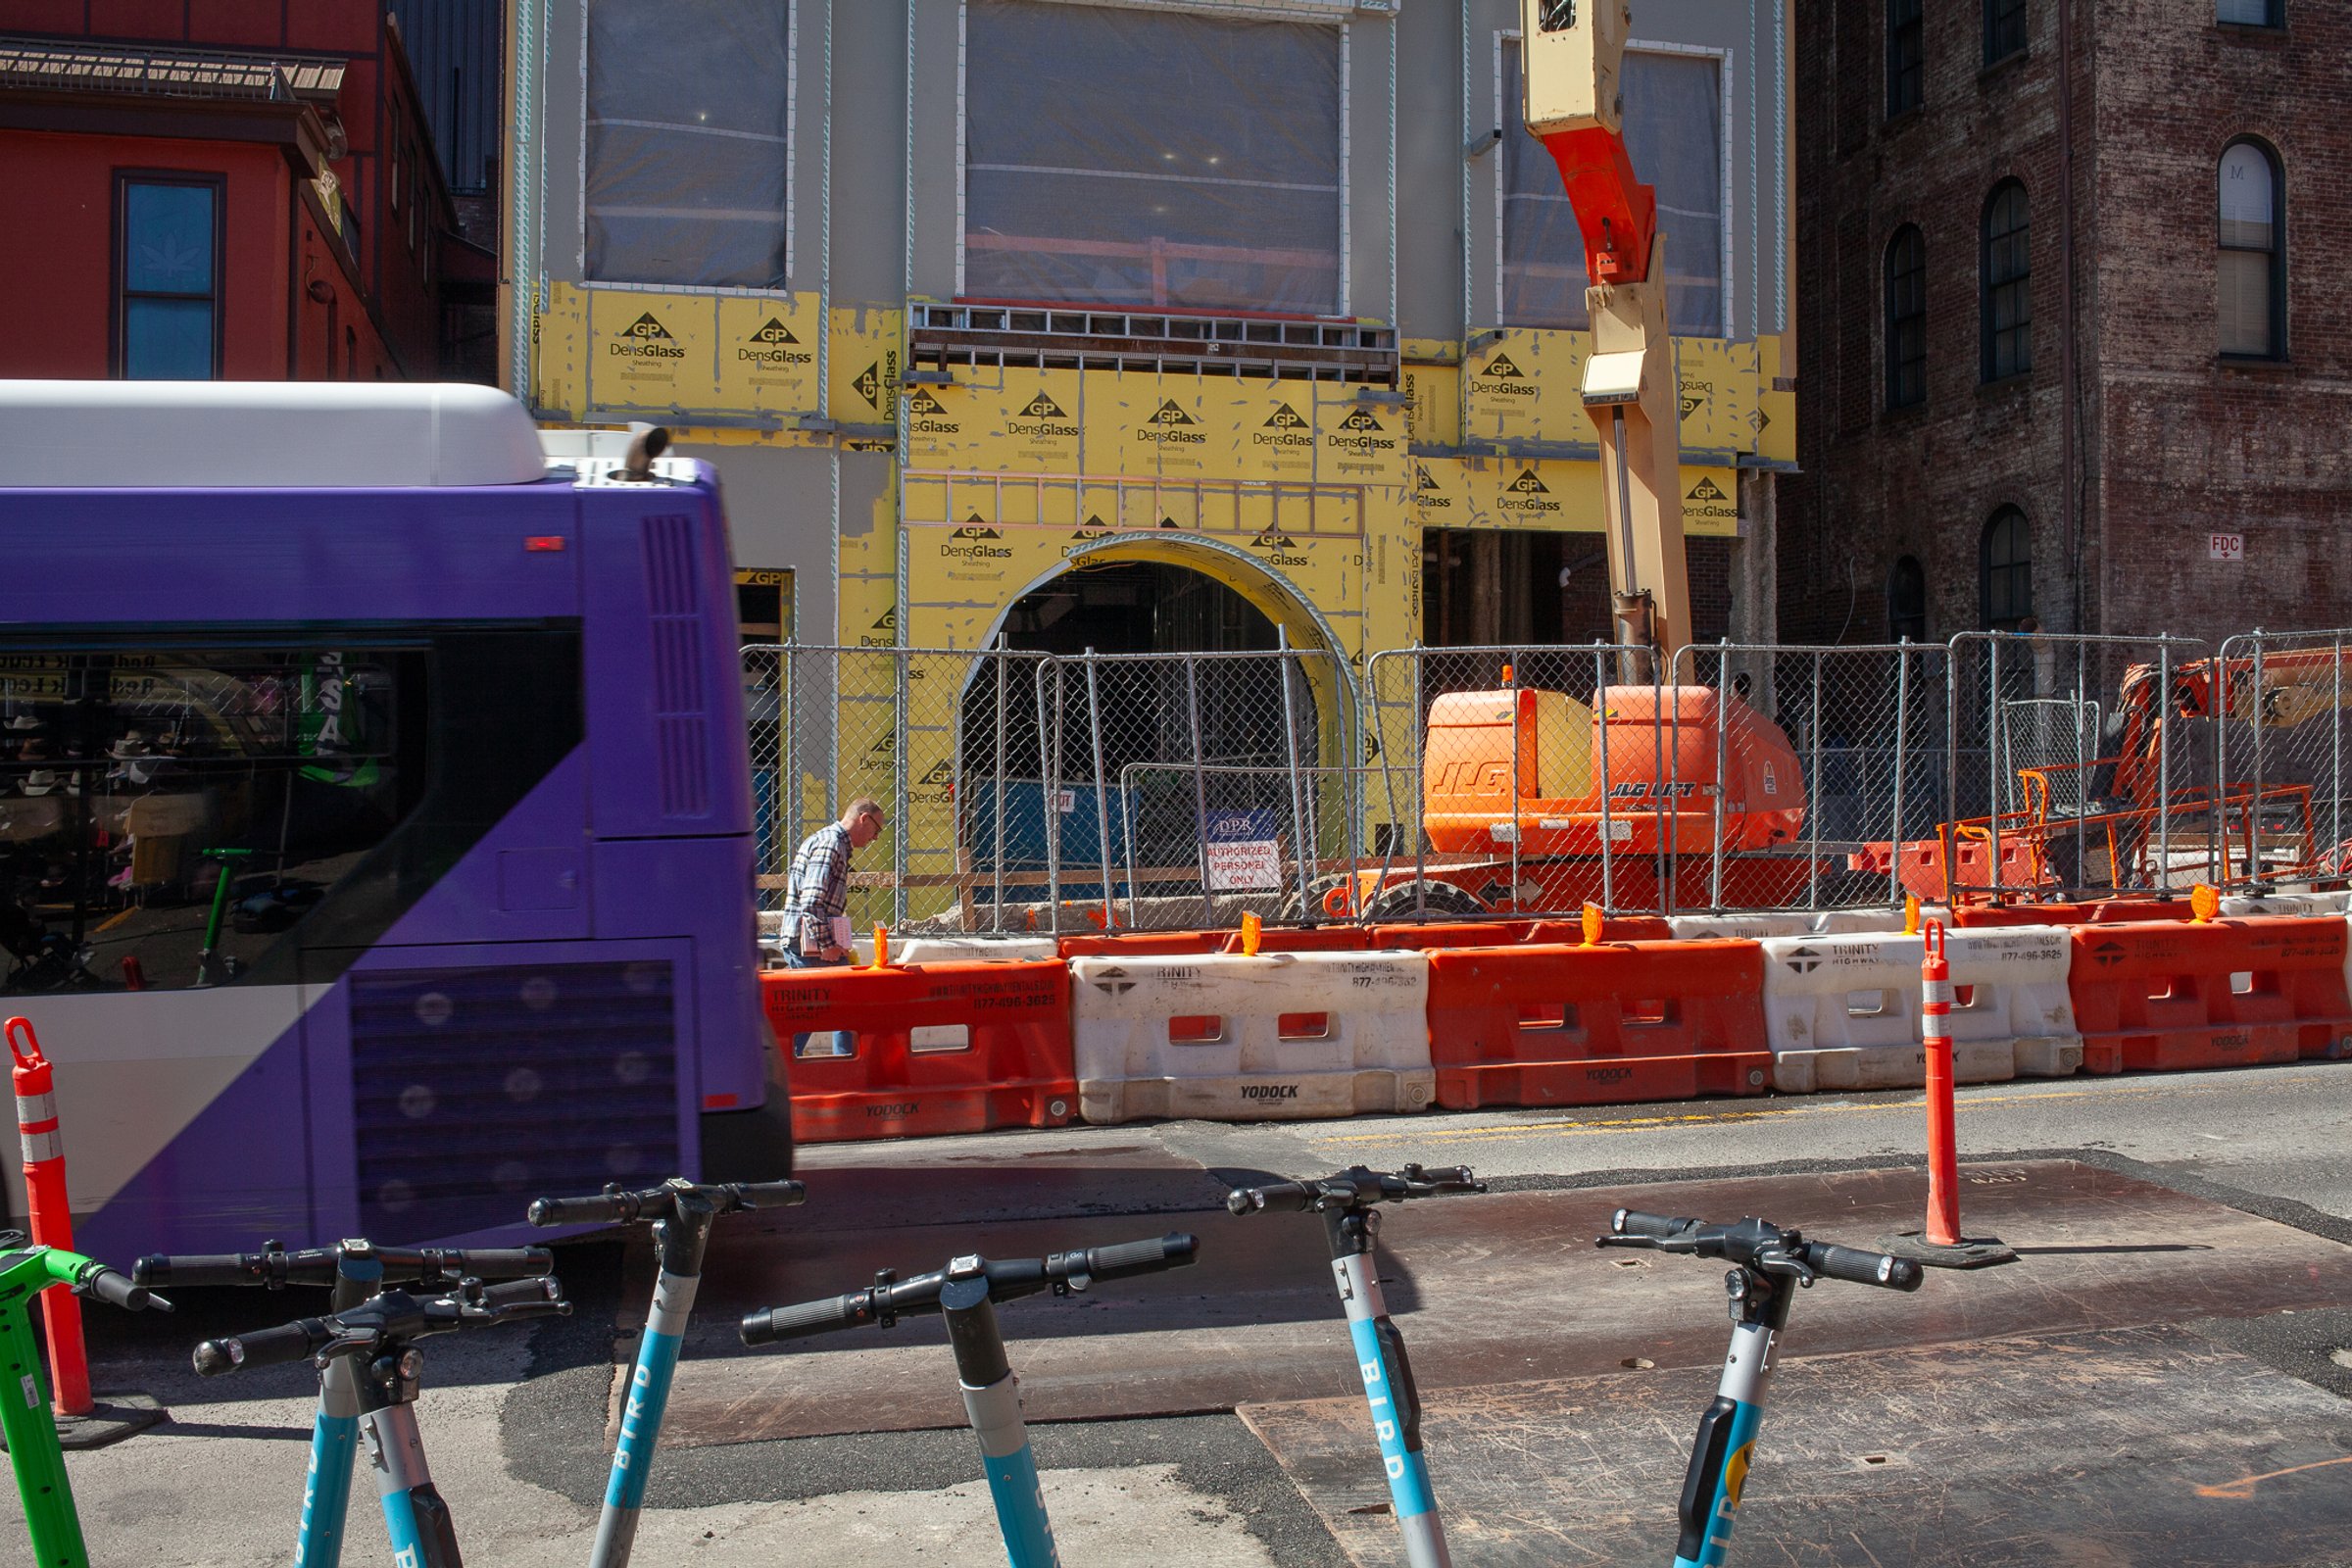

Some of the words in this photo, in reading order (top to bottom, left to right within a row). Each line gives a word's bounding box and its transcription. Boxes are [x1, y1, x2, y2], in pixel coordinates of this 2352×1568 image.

[2230, 165, 2244, 180] M
[633, 323, 661, 336] GP
[760, 328, 788, 342] GP
[610, 343, 685, 358] DensGlass
[738, 348, 811, 364] DensGlass
[632, 360, 662, 368] Sheathing
[758, 364, 790, 373] heathing
[1491, 364, 1514, 374] GP
[863, 372, 876, 399] GP
[1471, 381, 1535, 396] DensGlass
[910, 399, 935, 412] GP
[1029, 403, 1055, 415] GP
[1158, 410, 1183, 421] GP
[1274, 413, 1298, 426] GP
[1008, 422, 1079, 436] DensGlass
[1137, 429, 1206, 444] DensGlass
[1252, 432, 1313, 446] DensGlas
[1328, 435, 1395, 450] DensGlass
[1157, 445, 1185, 454] Sheathing
[1516, 479, 1539, 491] GP
[1694, 487, 1718, 498] GP
[1497, 498, 1560, 512] DensGlass
[2212, 535, 2240, 552] FDC
[940, 545, 1012, 559] DensGlass
[756, 572, 782, 584] GP
[860, 635, 896, 648] Dens
[1432, 760, 1509, 796] JLG
[1609, 782, 1648, 799] JLG
[1207, 845, 1271, 858] AUTHORIZED
[1230, 875, 1254, 885] ONLY
[2278, 903, 2314, 912] TRINITY
[1832, 944, 1880, 956] TRINITY
[1832, 956, 1881, 965] HIGHWAY
[1156, 966, 1201, 978] RINITY
[772, 988, 831, 1002] TRINITY
[1241, 1085, 1298, 1099] YODOCK
[866, 1100, 920, 1117] YODOCK
[613, 1363, 652, 1470] BIRD
[1360, 1357, 1405, 1480] BIRD
